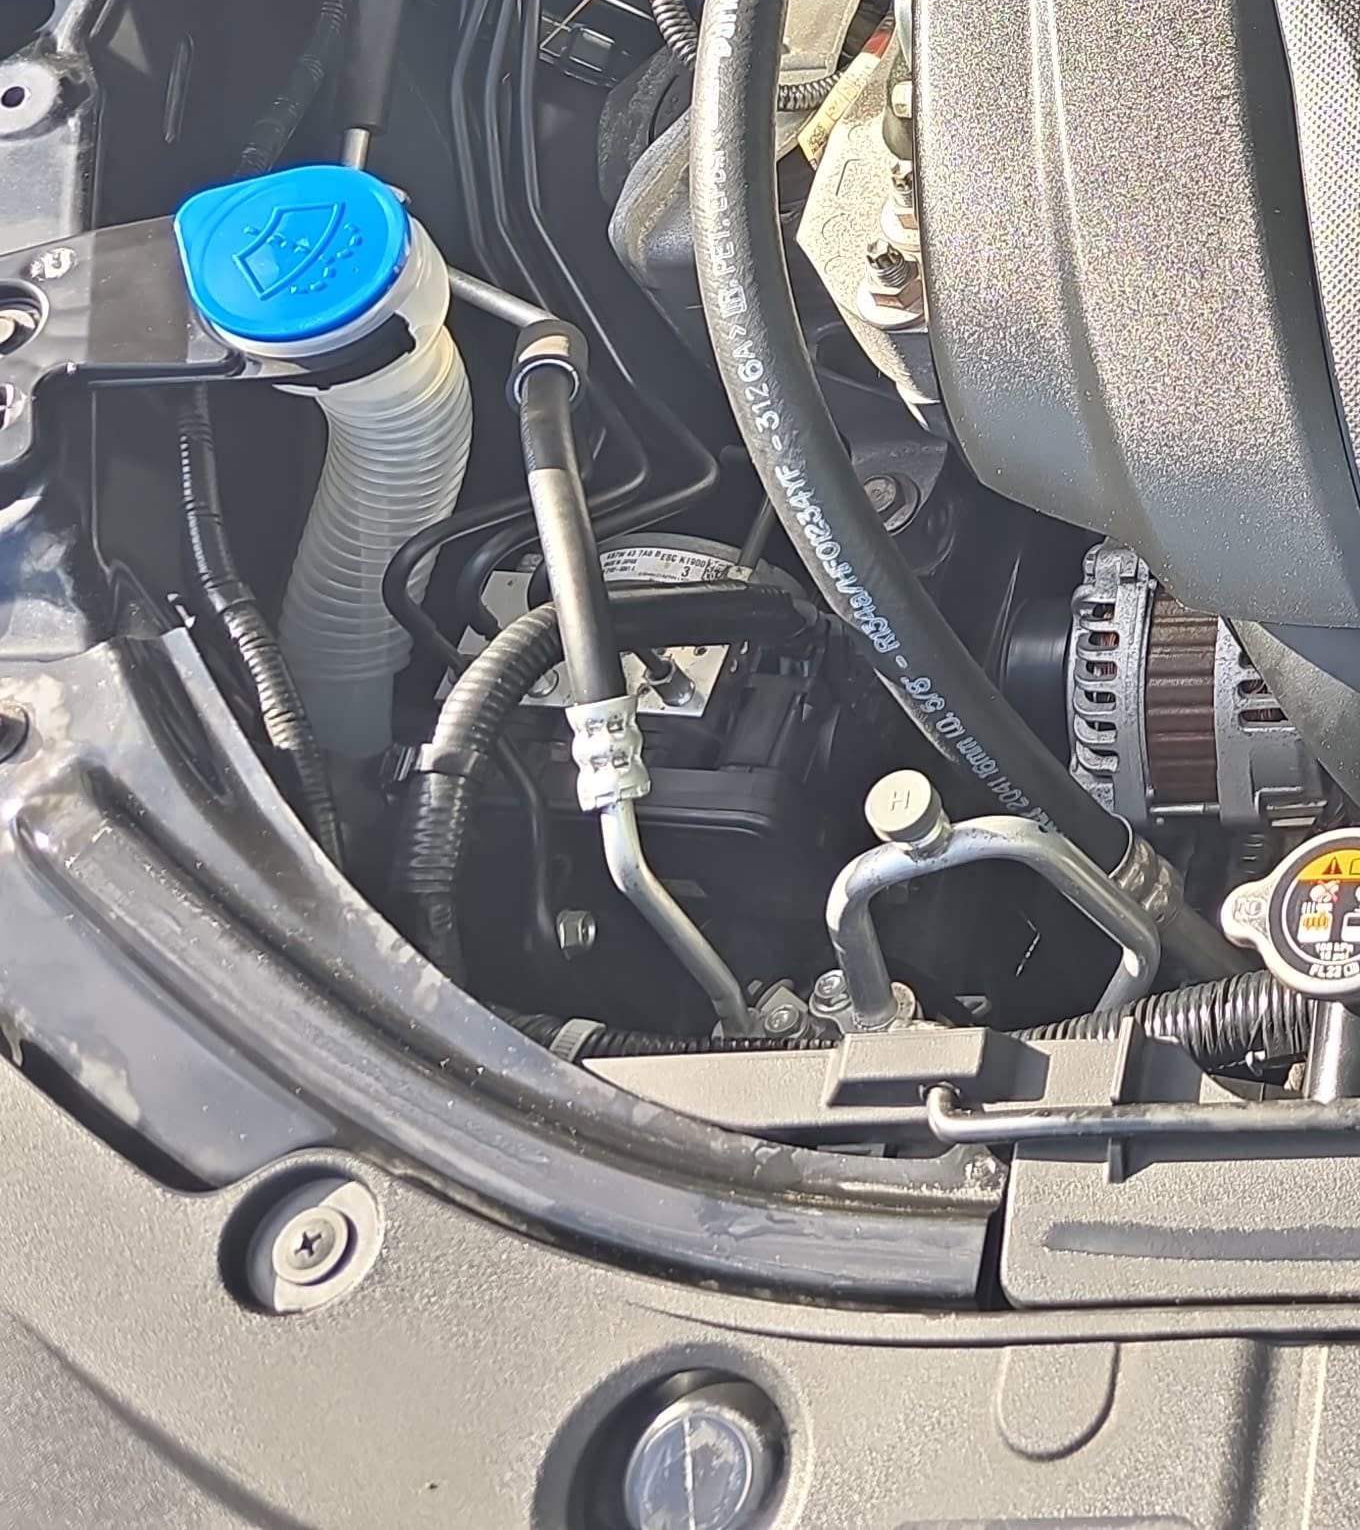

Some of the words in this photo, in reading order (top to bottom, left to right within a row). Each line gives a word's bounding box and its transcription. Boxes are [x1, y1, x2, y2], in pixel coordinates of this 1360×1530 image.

[659, 551, 678, 563] ESC
[680, 564, 691, 578] 3
[952, 733, 1001, 782] 16mm
[889, 789, 911, 812] H
[985, 773, 1031, 813] 2041
